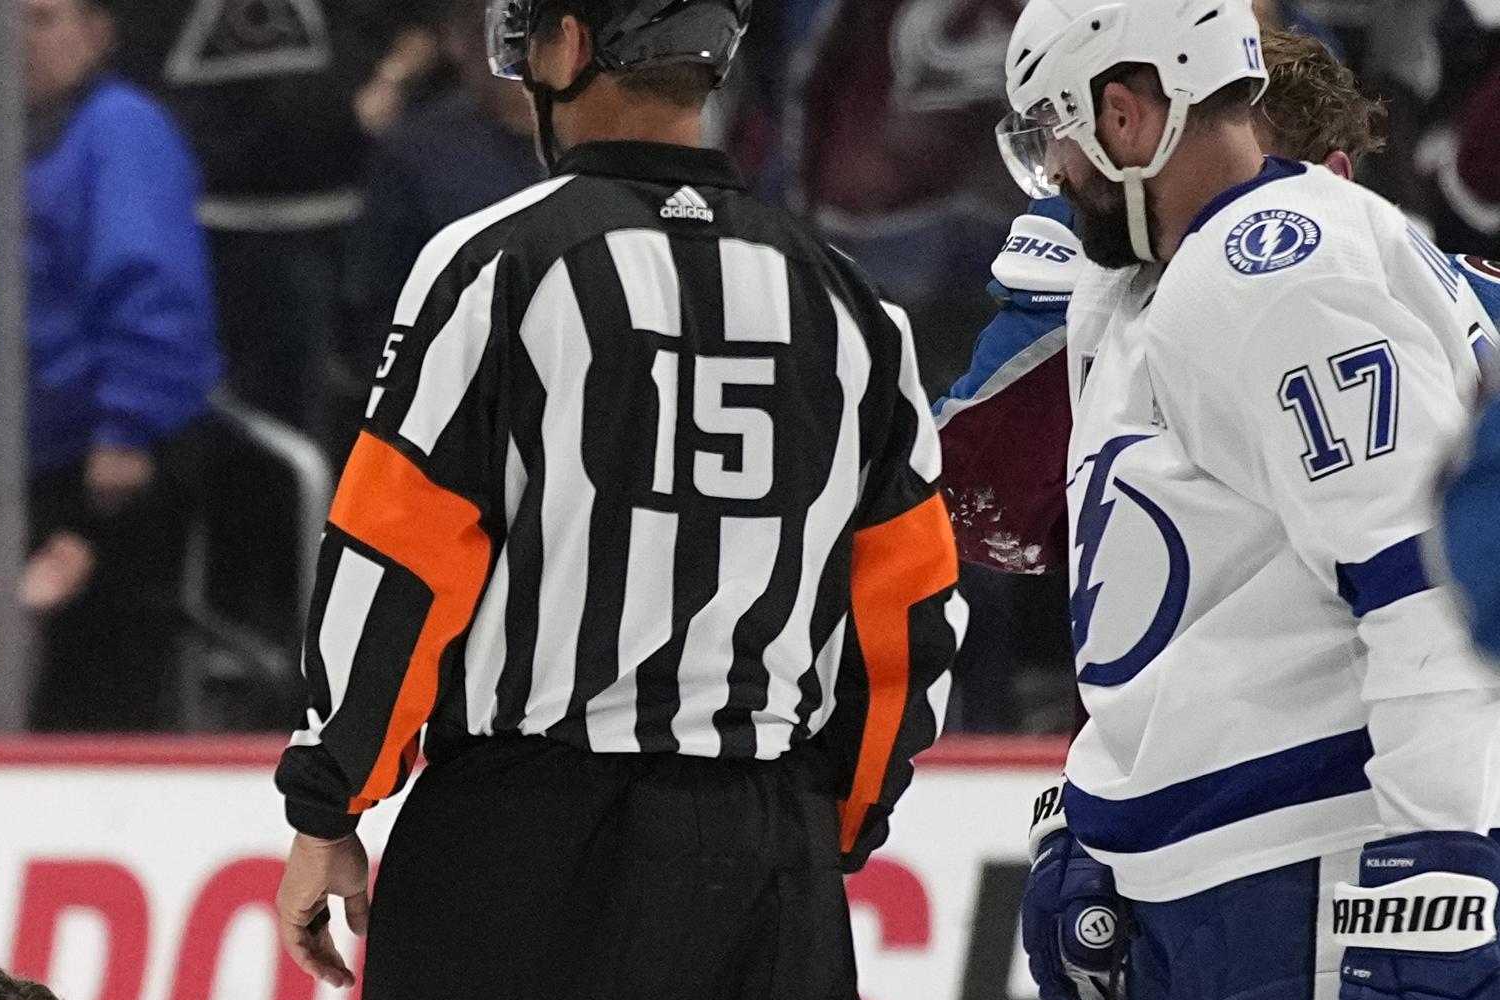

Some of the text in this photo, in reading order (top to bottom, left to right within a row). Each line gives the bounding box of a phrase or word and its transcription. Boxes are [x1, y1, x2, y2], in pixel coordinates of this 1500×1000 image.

[1242, 37, 1261, 70] 17
[659, 205, 714, 223] adidas
[1231, 215, 1256, 236] BAY
[1259, 210, 1318, 245] LIGHTNING
[1226, 238, 1254, 273] TAMPA
[650, 348, 776, 501] 15
[1276, 338, 1400, 483] 17
[1365, 857, 1417, 868] KILLORN
[1332, 895, 1487, 935] ARRIOR
